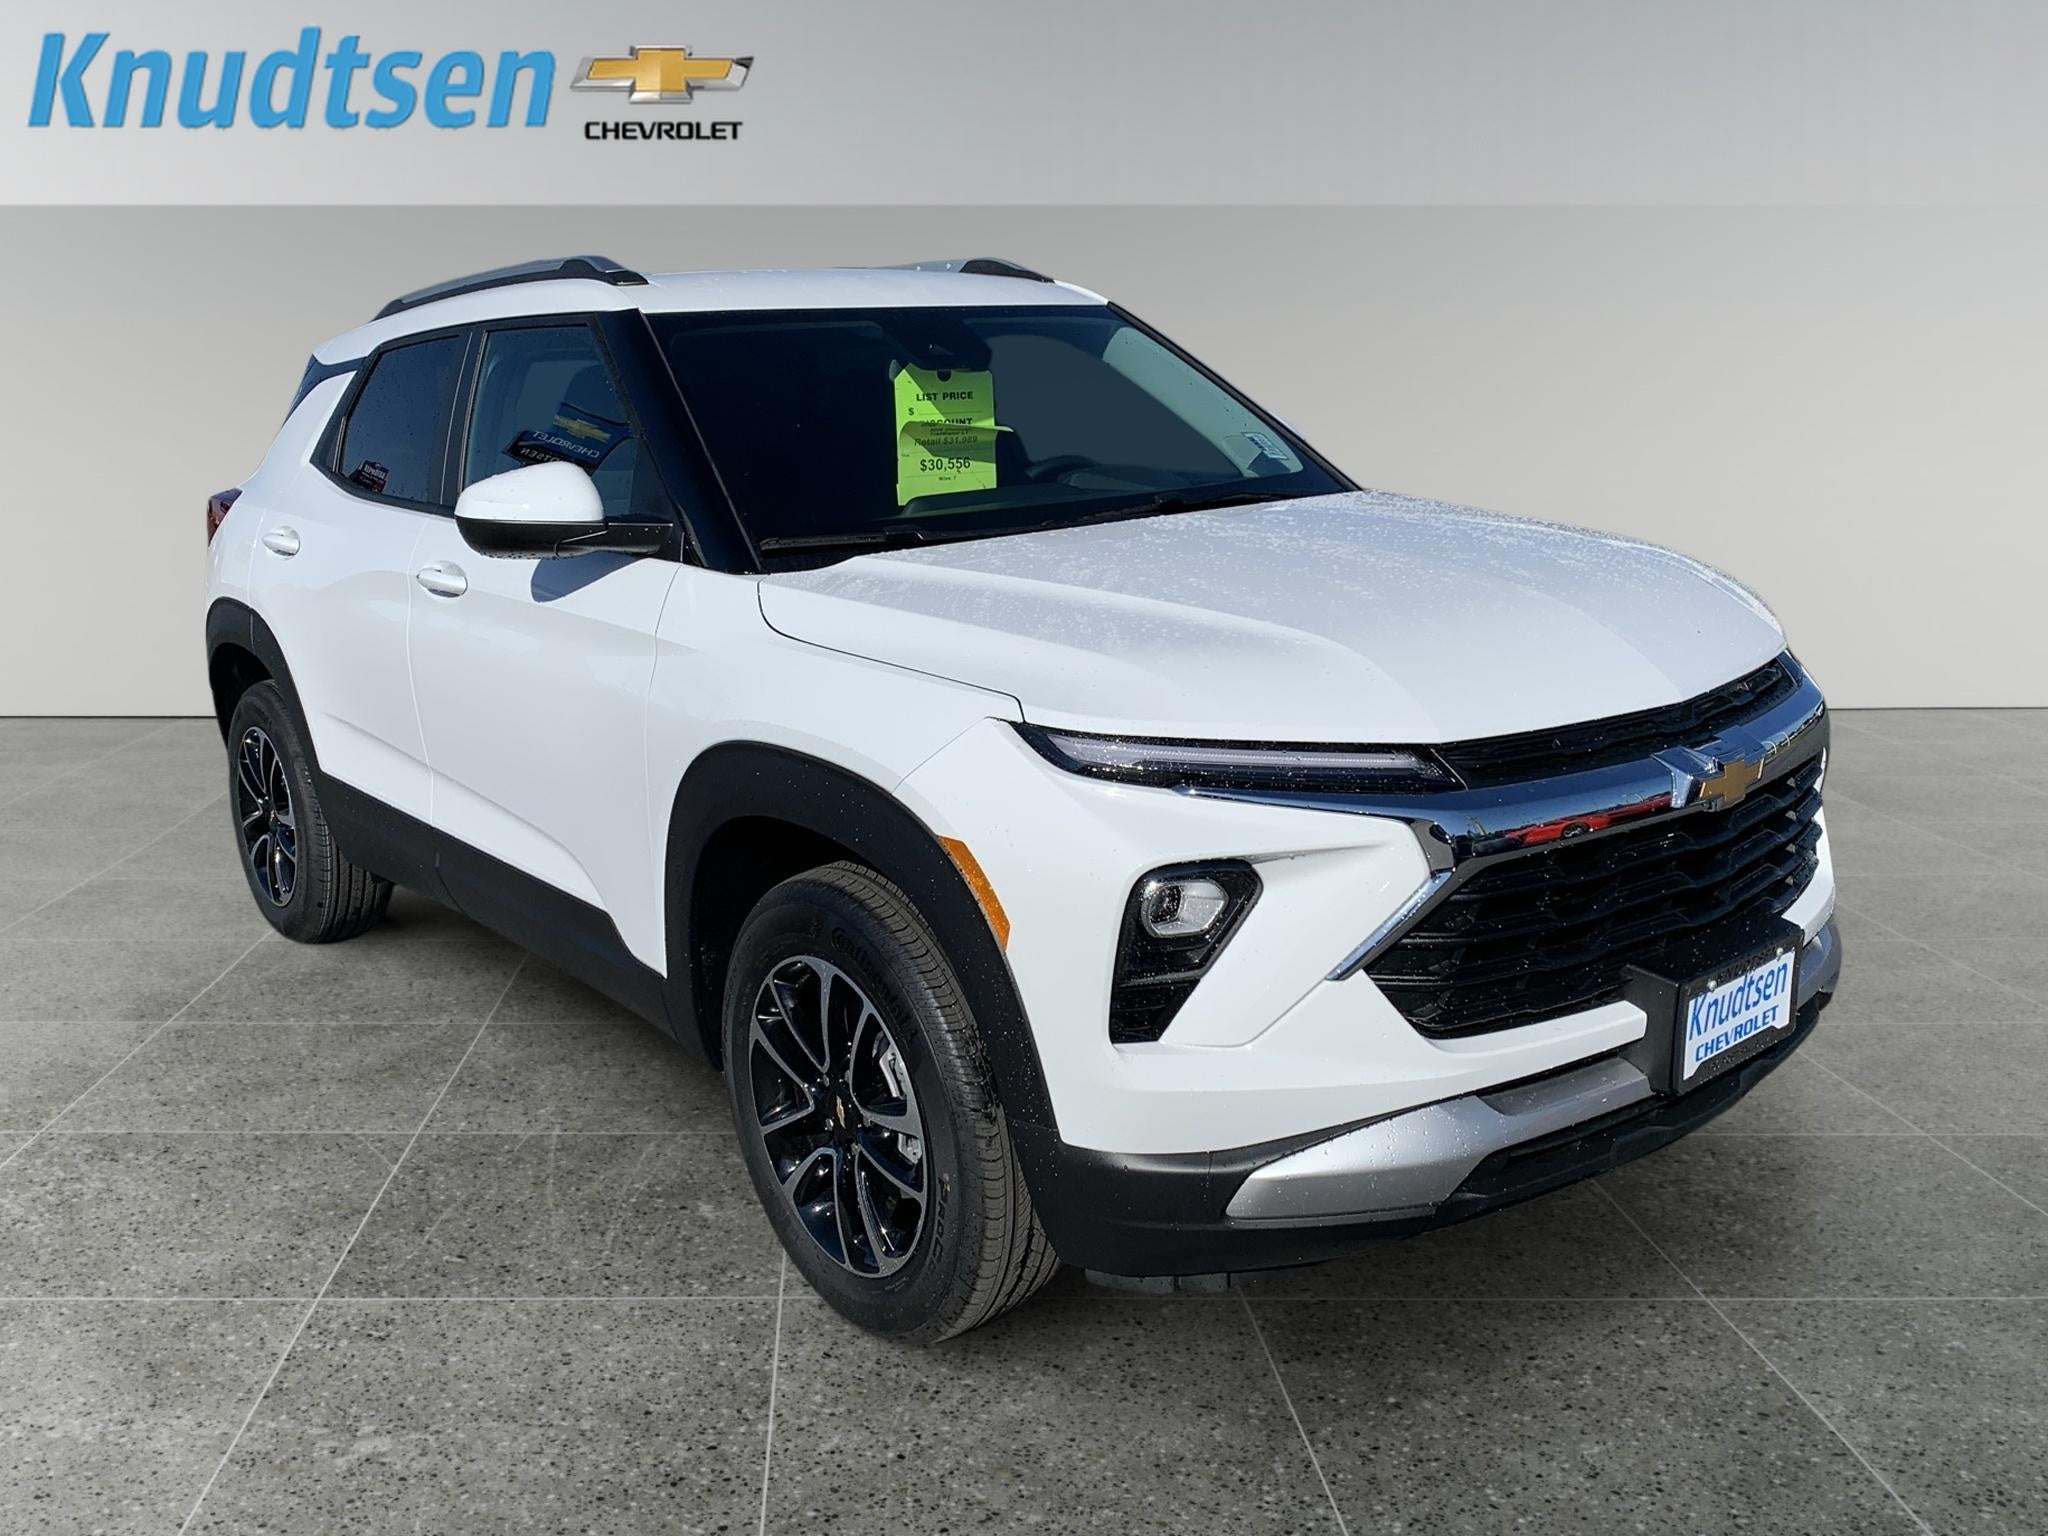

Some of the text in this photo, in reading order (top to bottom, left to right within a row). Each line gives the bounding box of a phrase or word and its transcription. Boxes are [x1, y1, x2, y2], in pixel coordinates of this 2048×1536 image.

[916, 391, 973, 402] LIST PRICE
[908, 407, 915, 416] $
[920, 457, 971, 472] $30,556
[1688, 961, 1789, 1042] Knudtsen
[1695, 1004, 1779, 1063] CHEVROLET
